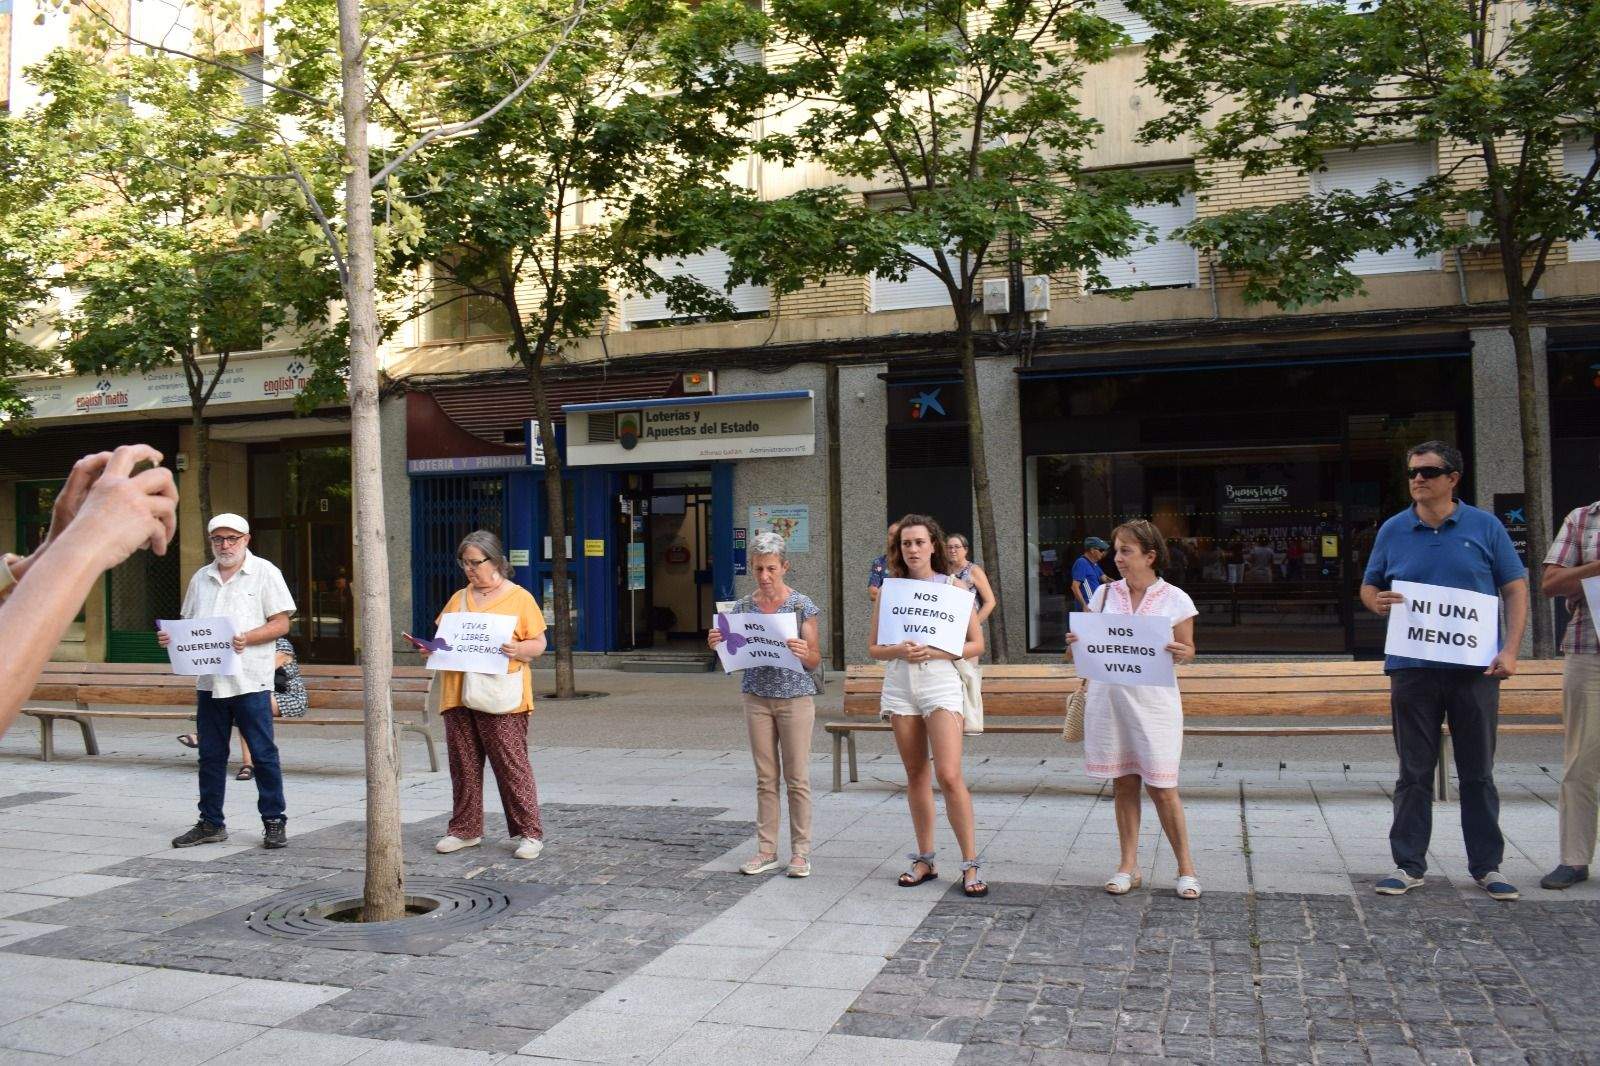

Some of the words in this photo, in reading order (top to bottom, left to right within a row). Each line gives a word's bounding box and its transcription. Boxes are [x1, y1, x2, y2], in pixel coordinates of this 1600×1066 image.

[264, 376, 294, 397] english
[76, 394, 102, 412] english
[105, 391, 128, 406] maths
[693, 410, 700, 422] y
[646, 425, 697, 439] Apuestas
[700, 422, 717, 434] del
[720, 420, 760, 433] Estado
[412, 460, 455, 471] LOTERIA
[462, 458, 469, 468] Y
[914, 592, 938, 602] NOS
[892, 606, 955, 622] QUEREMOS
[1411, 599, 1431, 614] NI
[1439, 603, 1479, 621] UNA
[462, 622, 487, 630] VIVAS
[744, 623, 765, 631] NOS
[903, 624, 936, 634] VIVAS
[191, 628, 212, 637] NOS
[1108, 627, 1134, 637] NOS
[1408, 626, 1478, 648] MENOS
[461, 633, 490, 642] LIBRES
[176, 641, 231, 651] QUEREMOS
[456, 644, 503, 655] QUEREMOS
[1087, 644, 1156, 656] QUEREMOS
[749, 650, 780, 658] VIVAS
[192, 657, 222, 665] VIVAS
[1104, 663, 1142, 673] VIVAS
